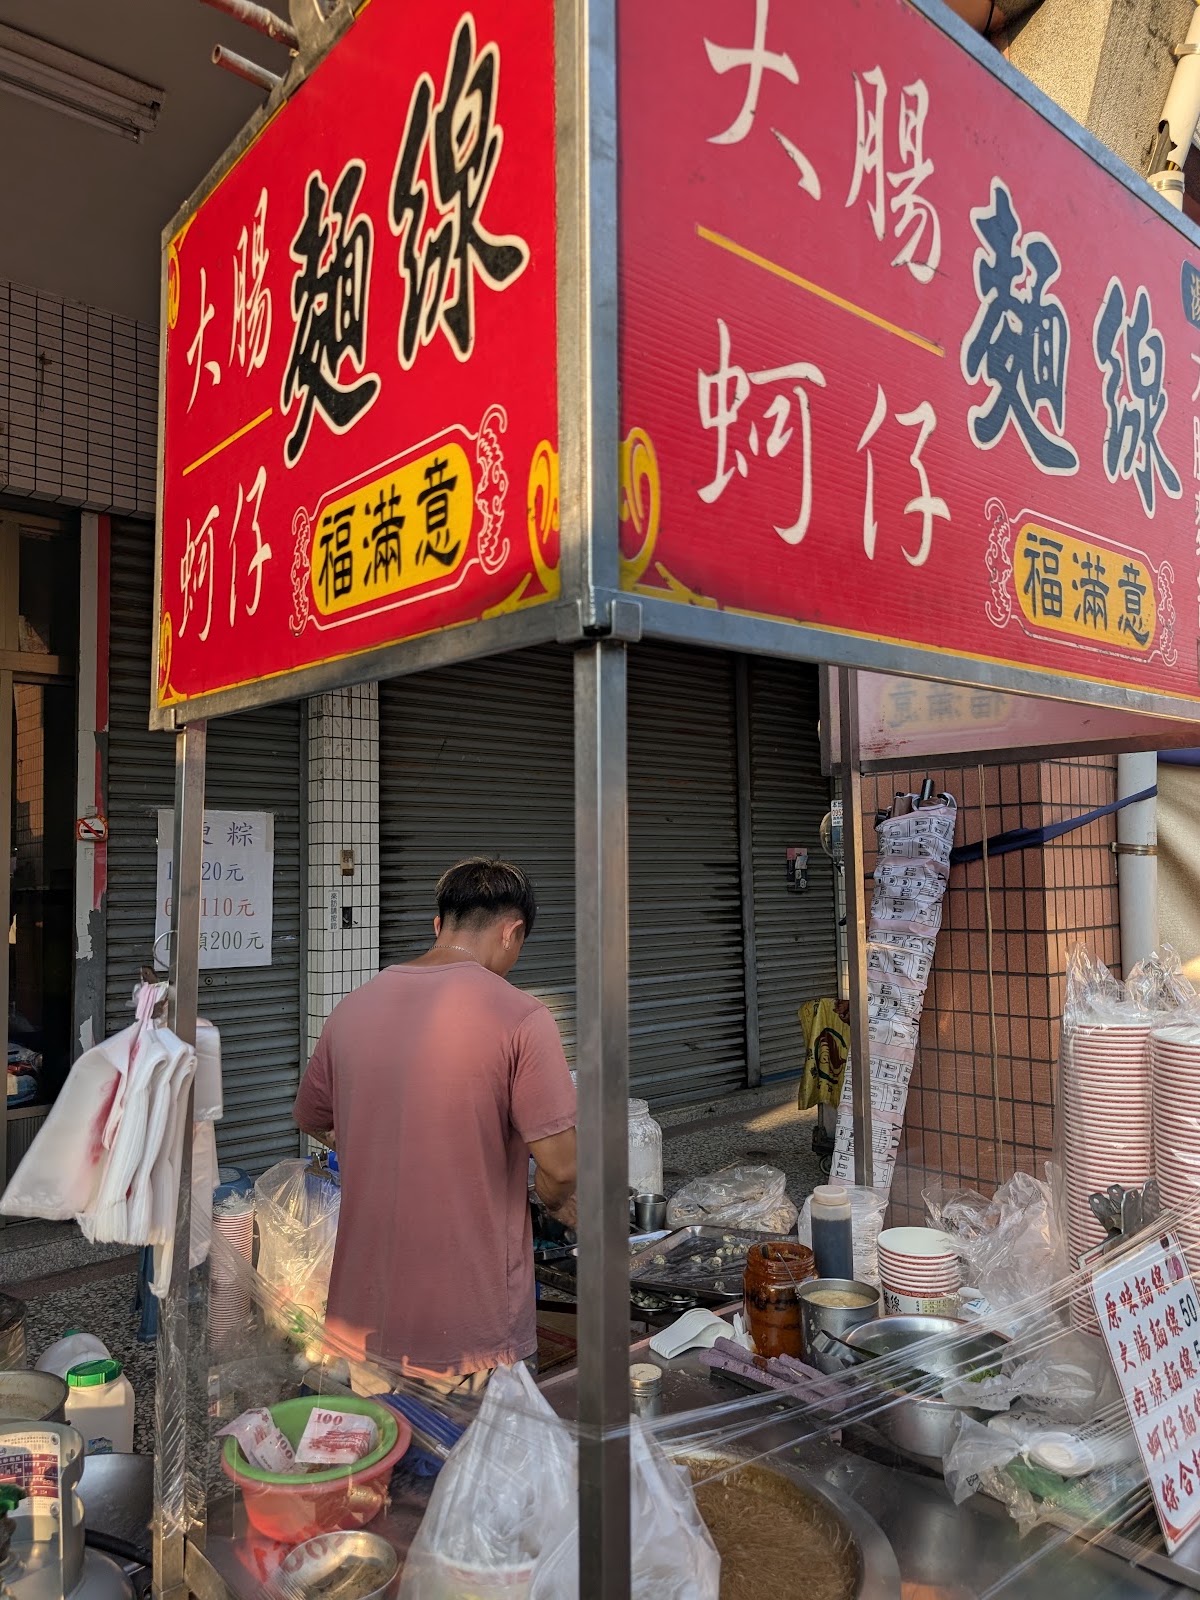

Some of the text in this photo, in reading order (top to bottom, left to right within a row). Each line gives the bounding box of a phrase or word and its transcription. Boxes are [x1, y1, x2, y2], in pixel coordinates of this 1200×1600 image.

[702, 0, 942, 283] 大腸
[186, 187, 273, 414] 大腸
[279, 11, 530, 469] 麵線
[960, 176, 1184, 519] 麵線
[697, 317, 951, 566] 蚵仔
[178, 465, 272, 642] 蚵仔
[318, 457, 463, 606] 福滿意
[1023, 531, 1151, 648] 福滿意
[1104, 1264, 1170, 1331] 原味麵線
[1118, 1293, 1198, 1373] 大腸麵線 50
[315, 1413, 343, 1426] 100
